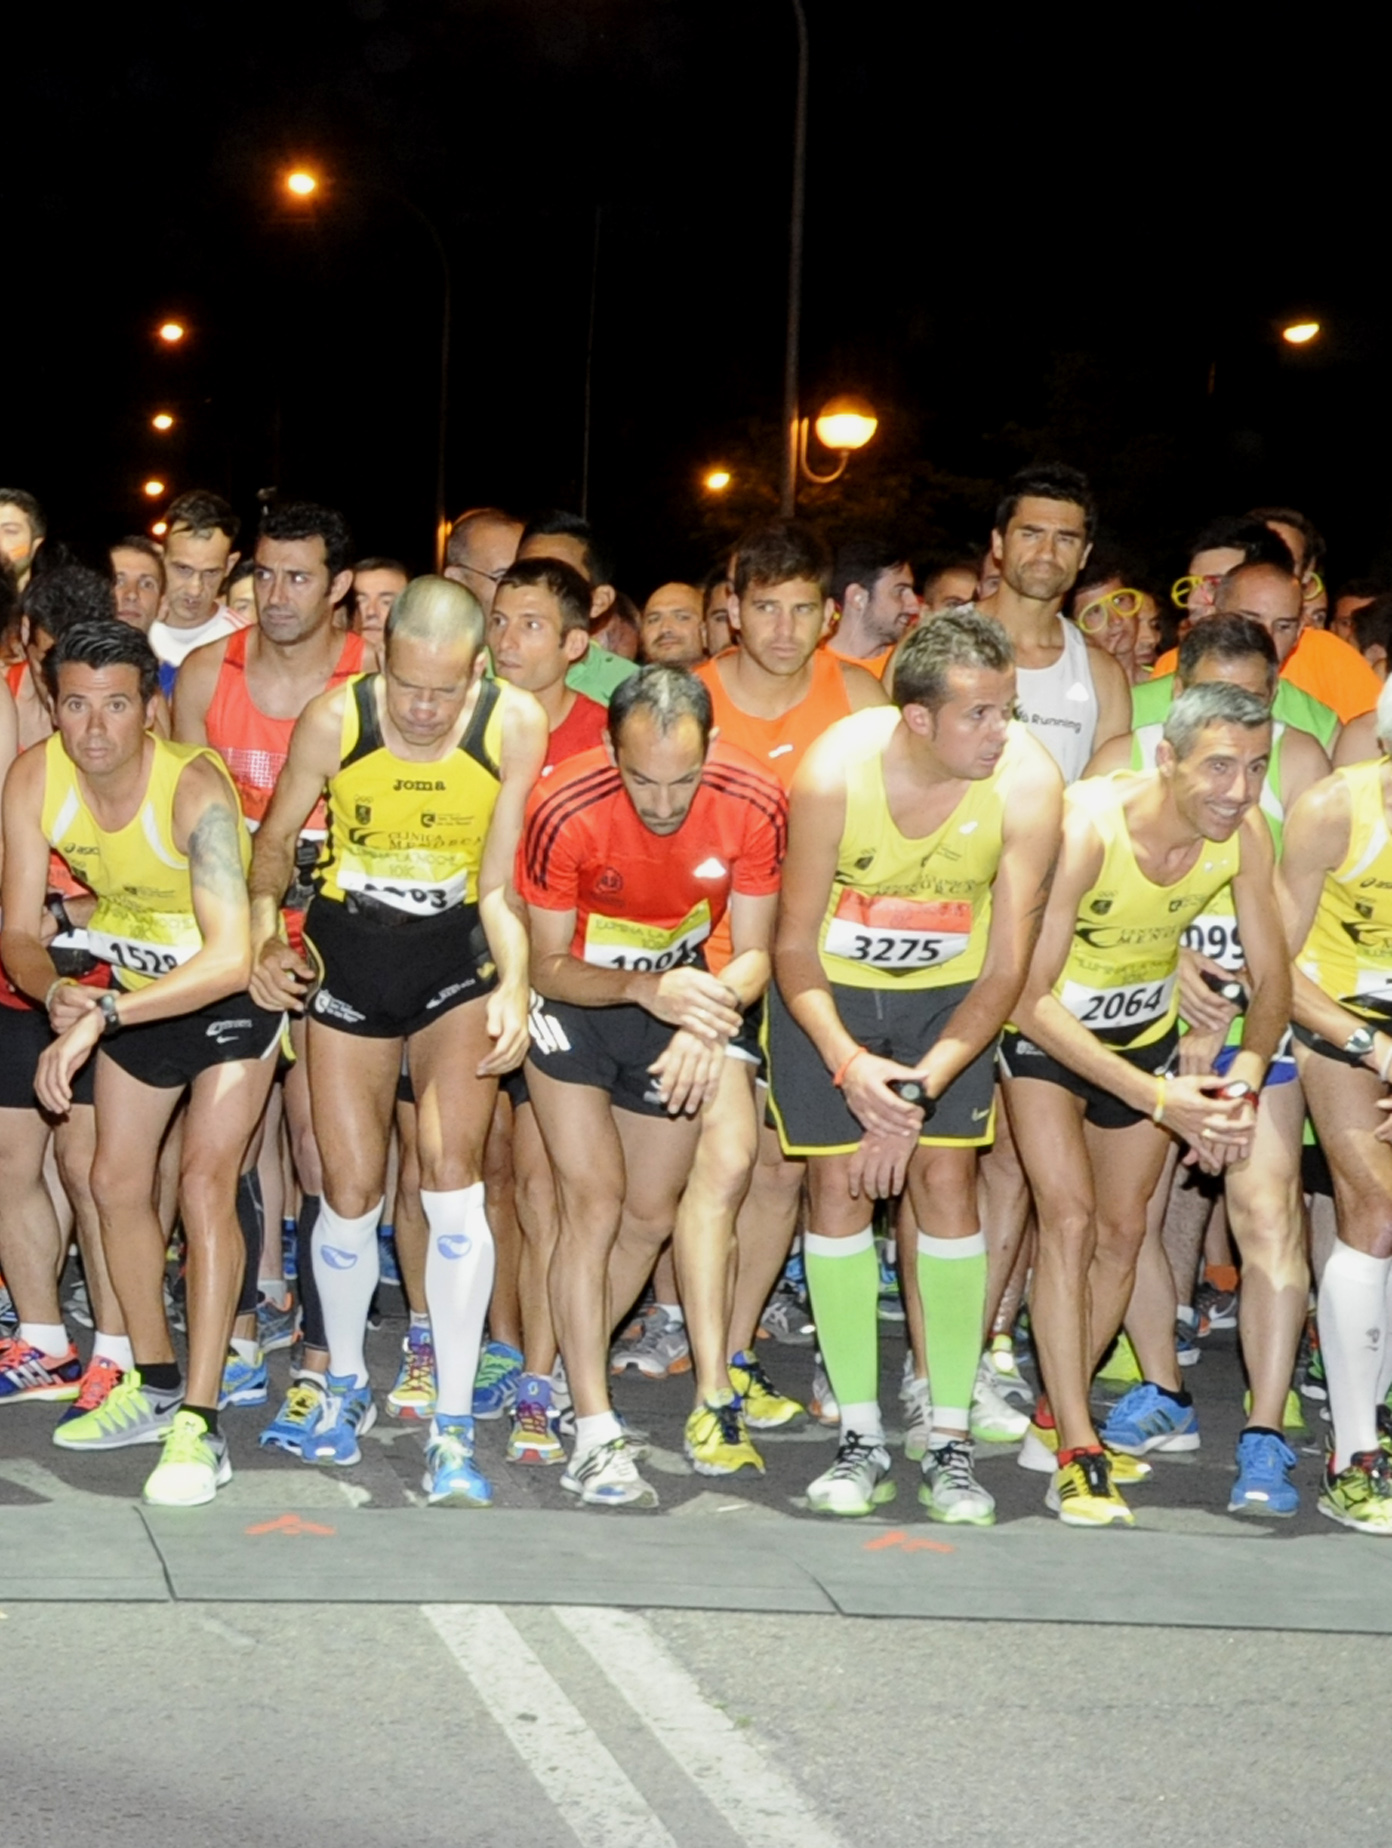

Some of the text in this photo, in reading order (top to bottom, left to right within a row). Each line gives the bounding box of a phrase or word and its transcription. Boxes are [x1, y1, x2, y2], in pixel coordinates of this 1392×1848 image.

[1032, 713, 1082, 735] Running
[849, 934, 943, 962] 3275
[1080, 983, 1166, 1021] 2064
